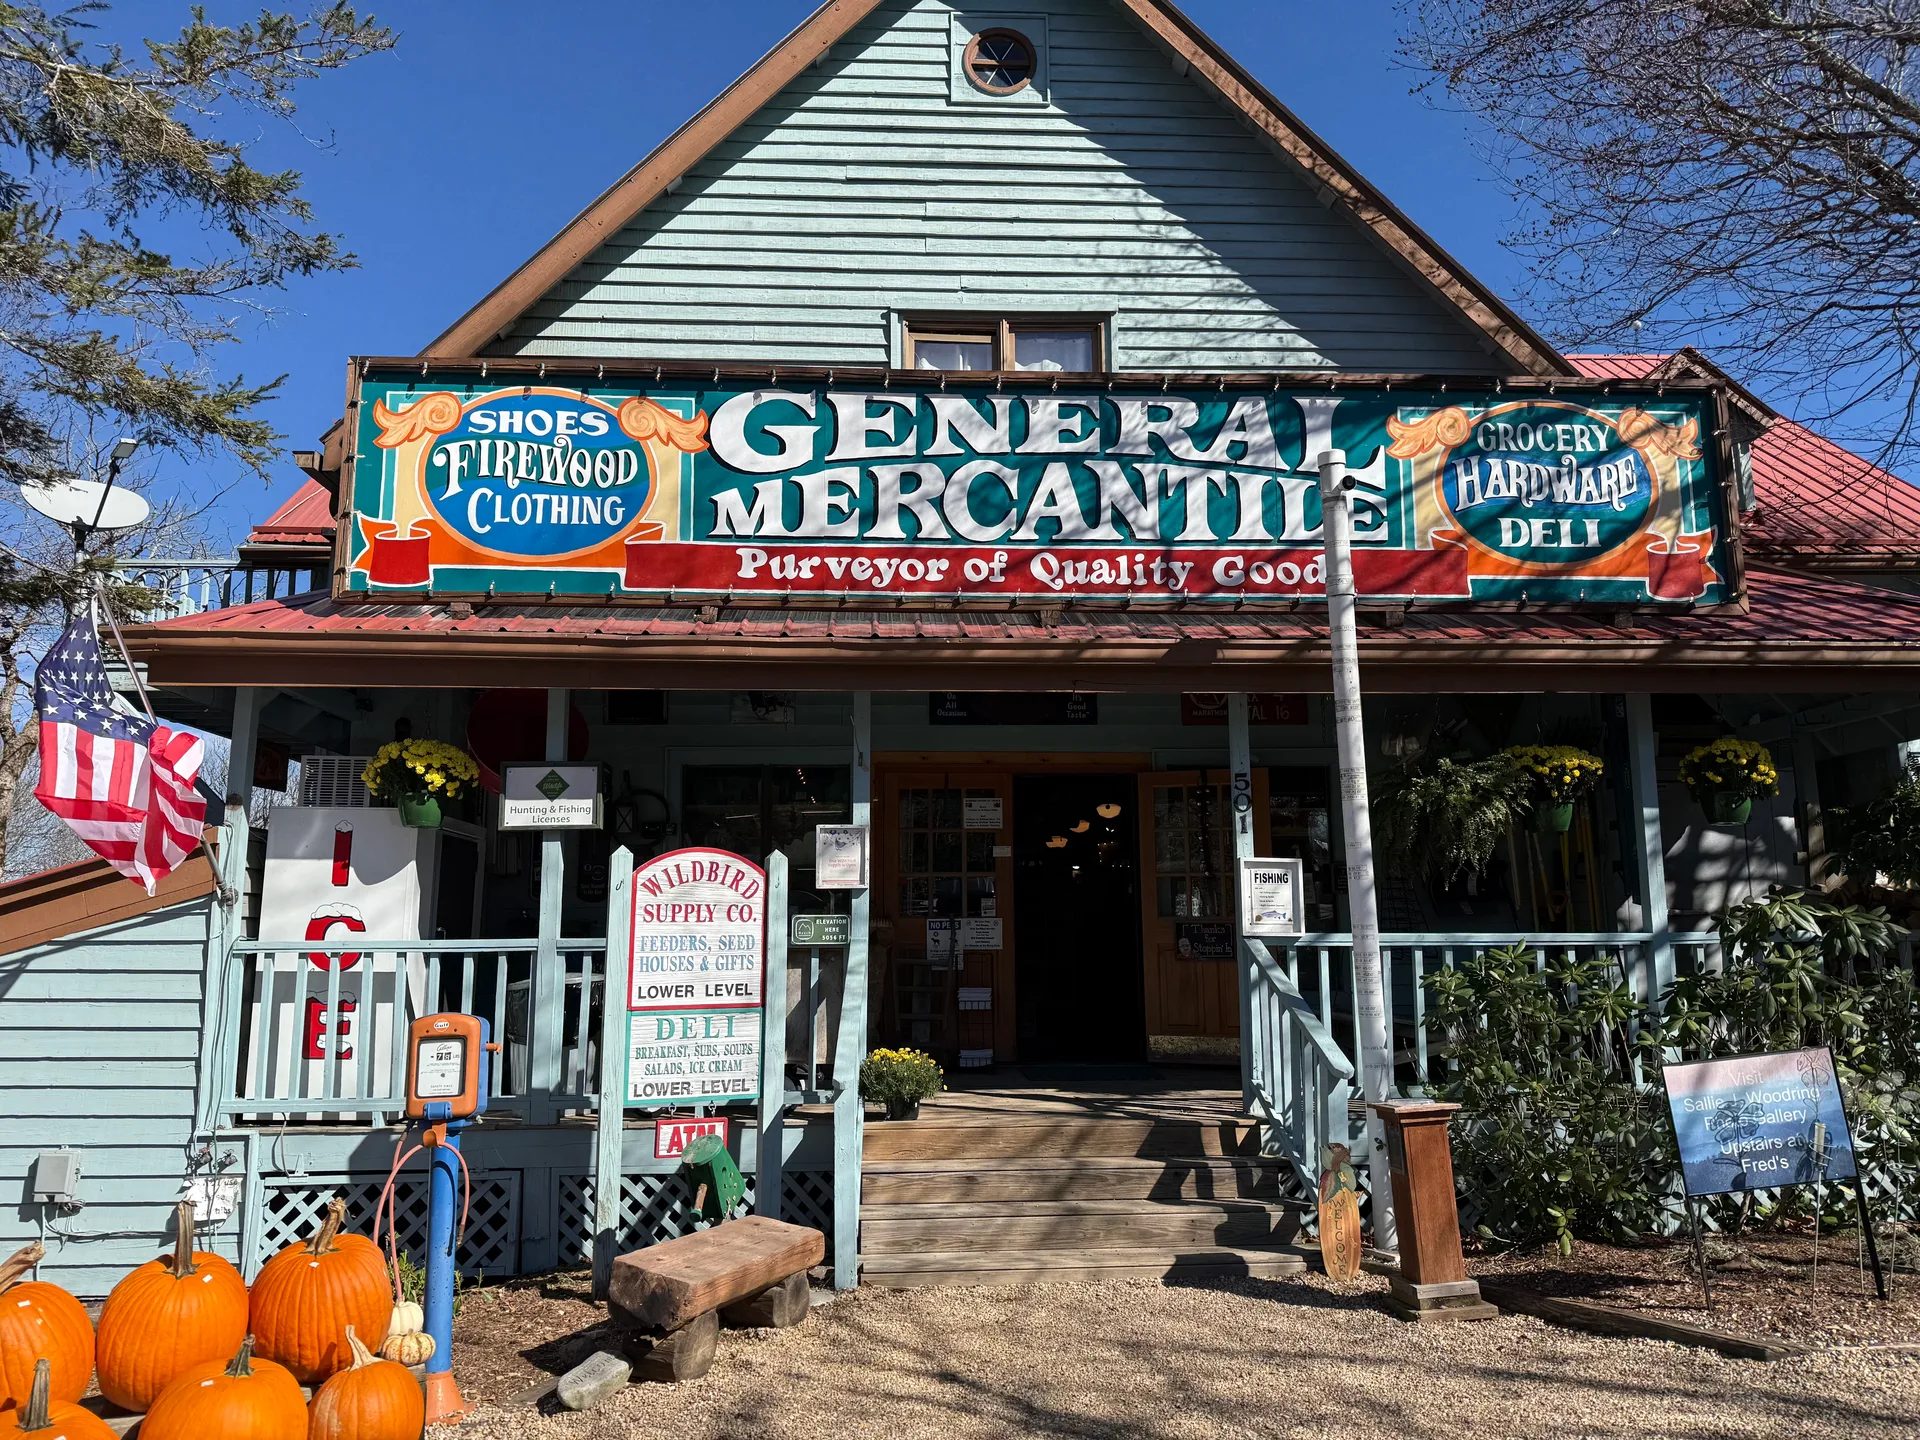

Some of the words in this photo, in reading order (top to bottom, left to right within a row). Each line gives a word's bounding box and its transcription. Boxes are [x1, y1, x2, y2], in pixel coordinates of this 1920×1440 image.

[468, 408, 611, 437] SHOES
[709, 389, 1386, 490] GENERAL
[1476, 421, 1611, 453] GROCERY
[432, 435, 638, 500] FIREWOOD
[1453, 453, 1640, 513] HARDWARE
[706, 459, 1389, 542] MERCANTILE
[467, 487, 626, 535] CLOTHING
[1499, 517, 1601, 548] DELI
[736, 547, 949, 588] Purveyor
[963, 550, 1009, 583] of
[1029, 550, 1196, 590] Quality
[1218, 553, 1327, 587] Good
[937, 709, 967, 717] Occasions
[1191, 709, 1228, 717] MARATHON
[509, 805, 547, 815] Hunting
[549, 805, 557, 814] &
[558, 805, 591, 815] Fishing
[1233, 772, 1251, 835] 501
[532, 815, 571, 824] Licenses
[640, 860, 760, 900] WILDBIRD
[1254, 872, 1289, 884] FISHING
[642, 903, 717, 924] SUPPLY
[726, 904, 757, 923] CO.
[930, 921, 941, 930] NO
[941, 921, 960, 930] PES
[1190, 923, 1226, 934] Thanks
[302, 821, 367, 1060] ICE
[640, 934, 712, 954] FEEDERS,
[718, 934, 756, 951] SEED
[1204, 933, 1217, 943] for
[1193, 942, 1224, 955] Stoppin'
[638, 955, 695, 972] HOUSES
[699, 955, 709, 972] &
[715, 954, 755, 971] GIFTS
[637, 984, 695, 999] LOWER
[705, 983, 753, 997] LEVEL
[654, 1016, 736, 1041] DELI
[634, 1045, 691, 1060] BREAKFAST,
[694, 1044, 720, 1058] SUBS,
[723, 1043, 753, 1056] SOUPS
[644, 1062, 685, 1077] SALADS,
[689, 1061, 705, 1074] ICE
[708, 1059, 742, 1073] CREAM
[633, 1081, 692, 1098] LOWER
[701, 1078, 750, 1094] LEVEL
[1730, 1071, 1764, 1087] Visit
[1684, 1096, 1724, 1113] Sallie
[1745, 1086, 1820, 1105] Woodring
[1755, 1108, 1807, 1125] Gallery
[1720, 1135, 1783, 1157] Upstairs
[1741, 1155, 1789, 1173] Fred's
[1329, 1199, 1349, 1275] WELCOME
